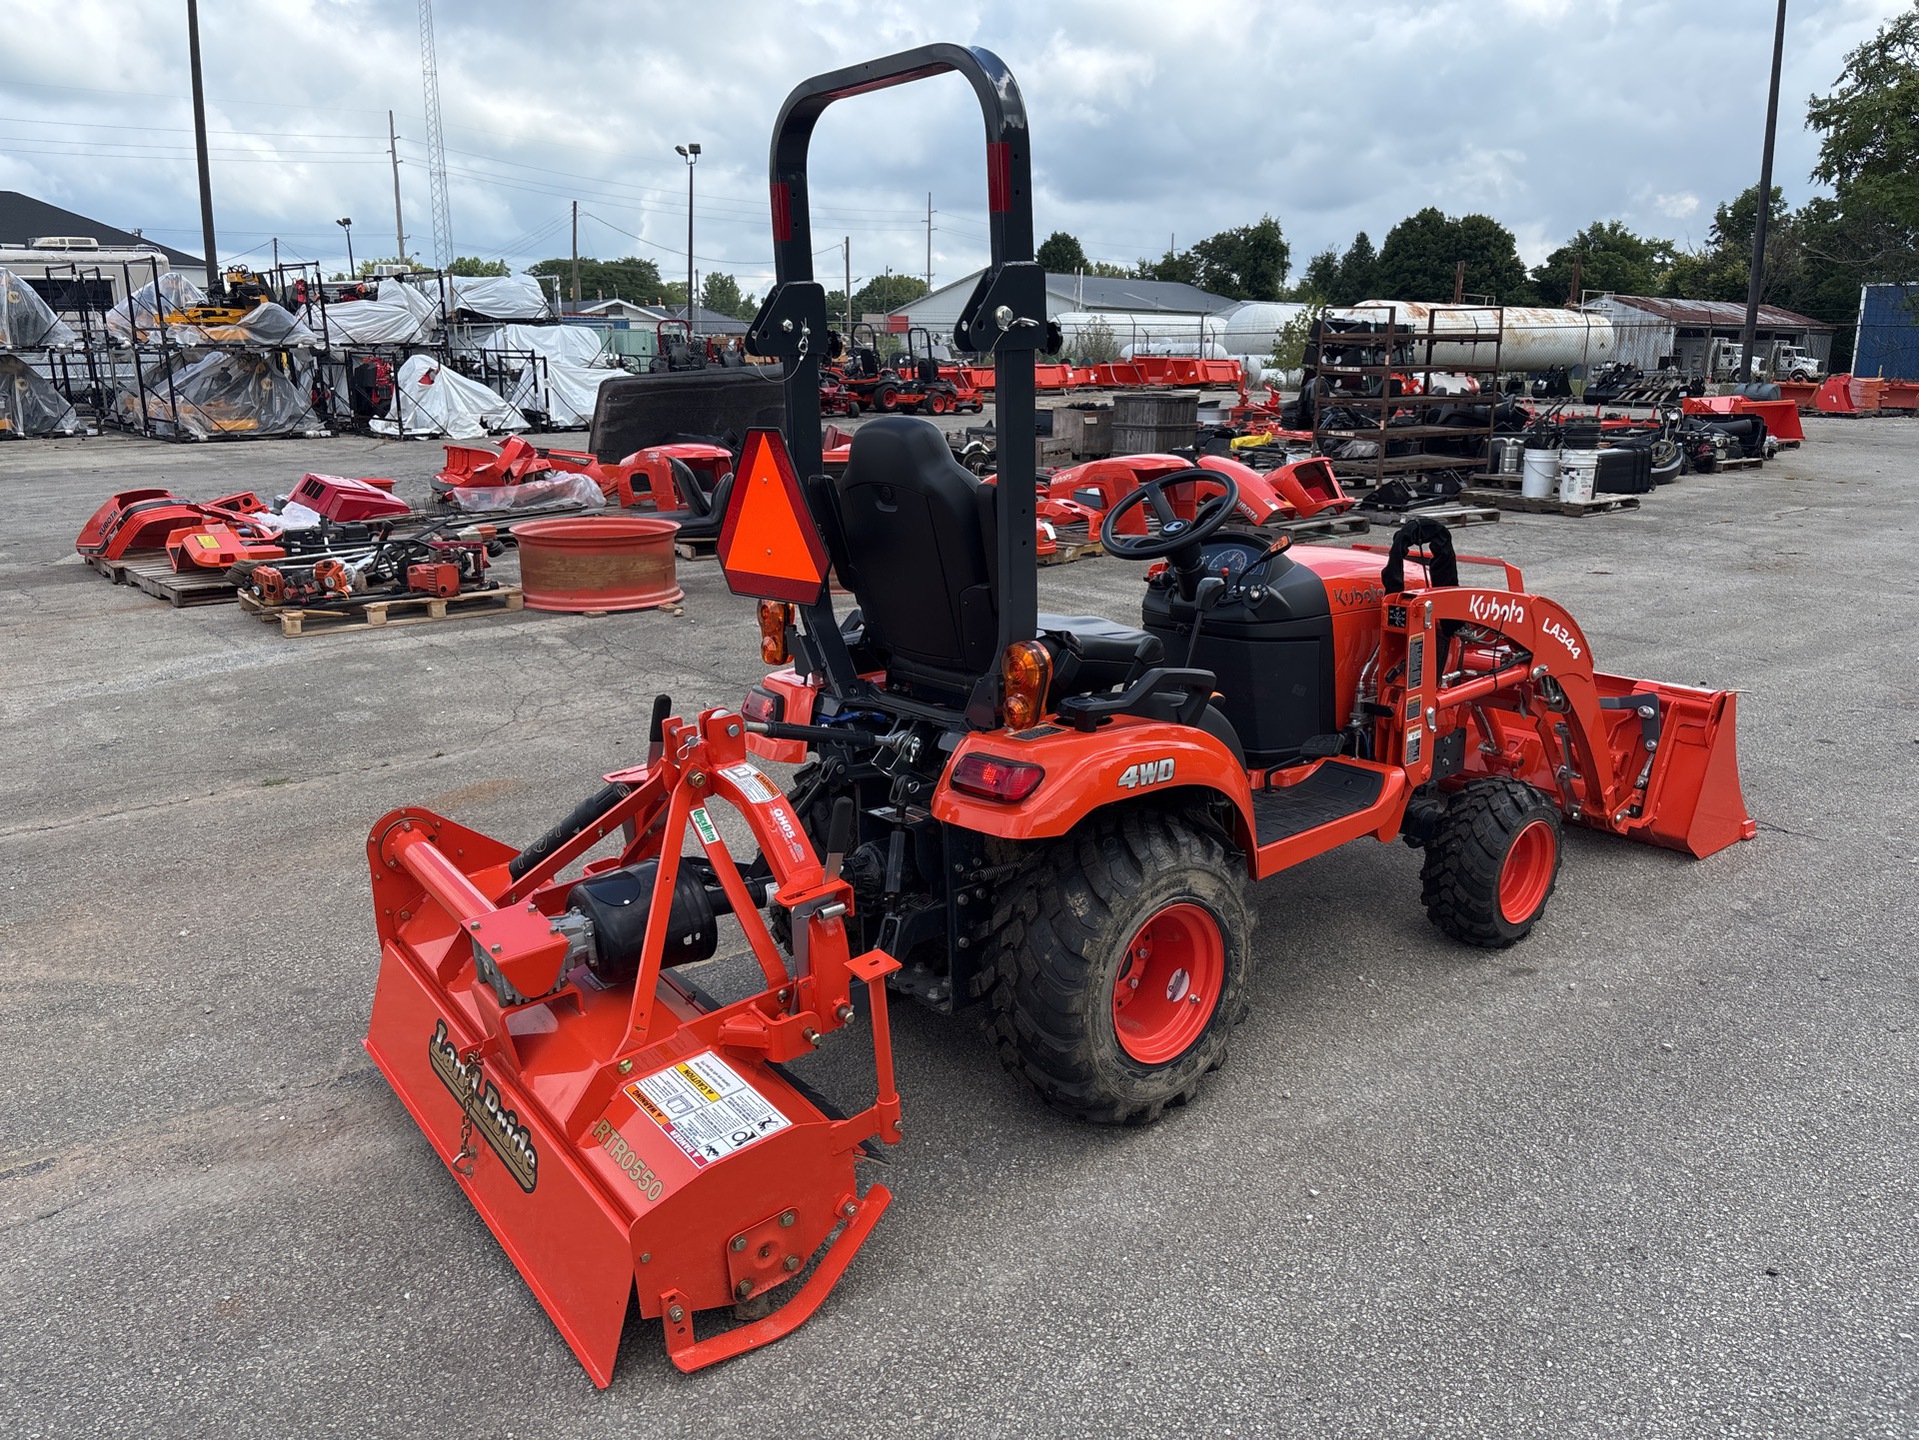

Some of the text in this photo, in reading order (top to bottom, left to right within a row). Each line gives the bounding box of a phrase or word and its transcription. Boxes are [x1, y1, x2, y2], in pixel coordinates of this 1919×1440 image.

[98, 510, 119, 538] KUBOTA
[1237, 499, 1259, 521] UBOTA
[1332, 583, 1385, 607] Kubota
[1469, 594, 1525, 624] Kubota
[1542, 617, 1582, 660] LA344
[1117, 757, 1175, 789] 4WD
[773, 808, 796, 839] QH05
[683, 1069, 708, 1091] CAUTION
[632, 1089, 658, 1113] WARNING
[480, 1085, 536, 1176] Pride
[670, 1129, 696, 1156] DANGER
[592, 1117, 664, 1202] RTR0550
